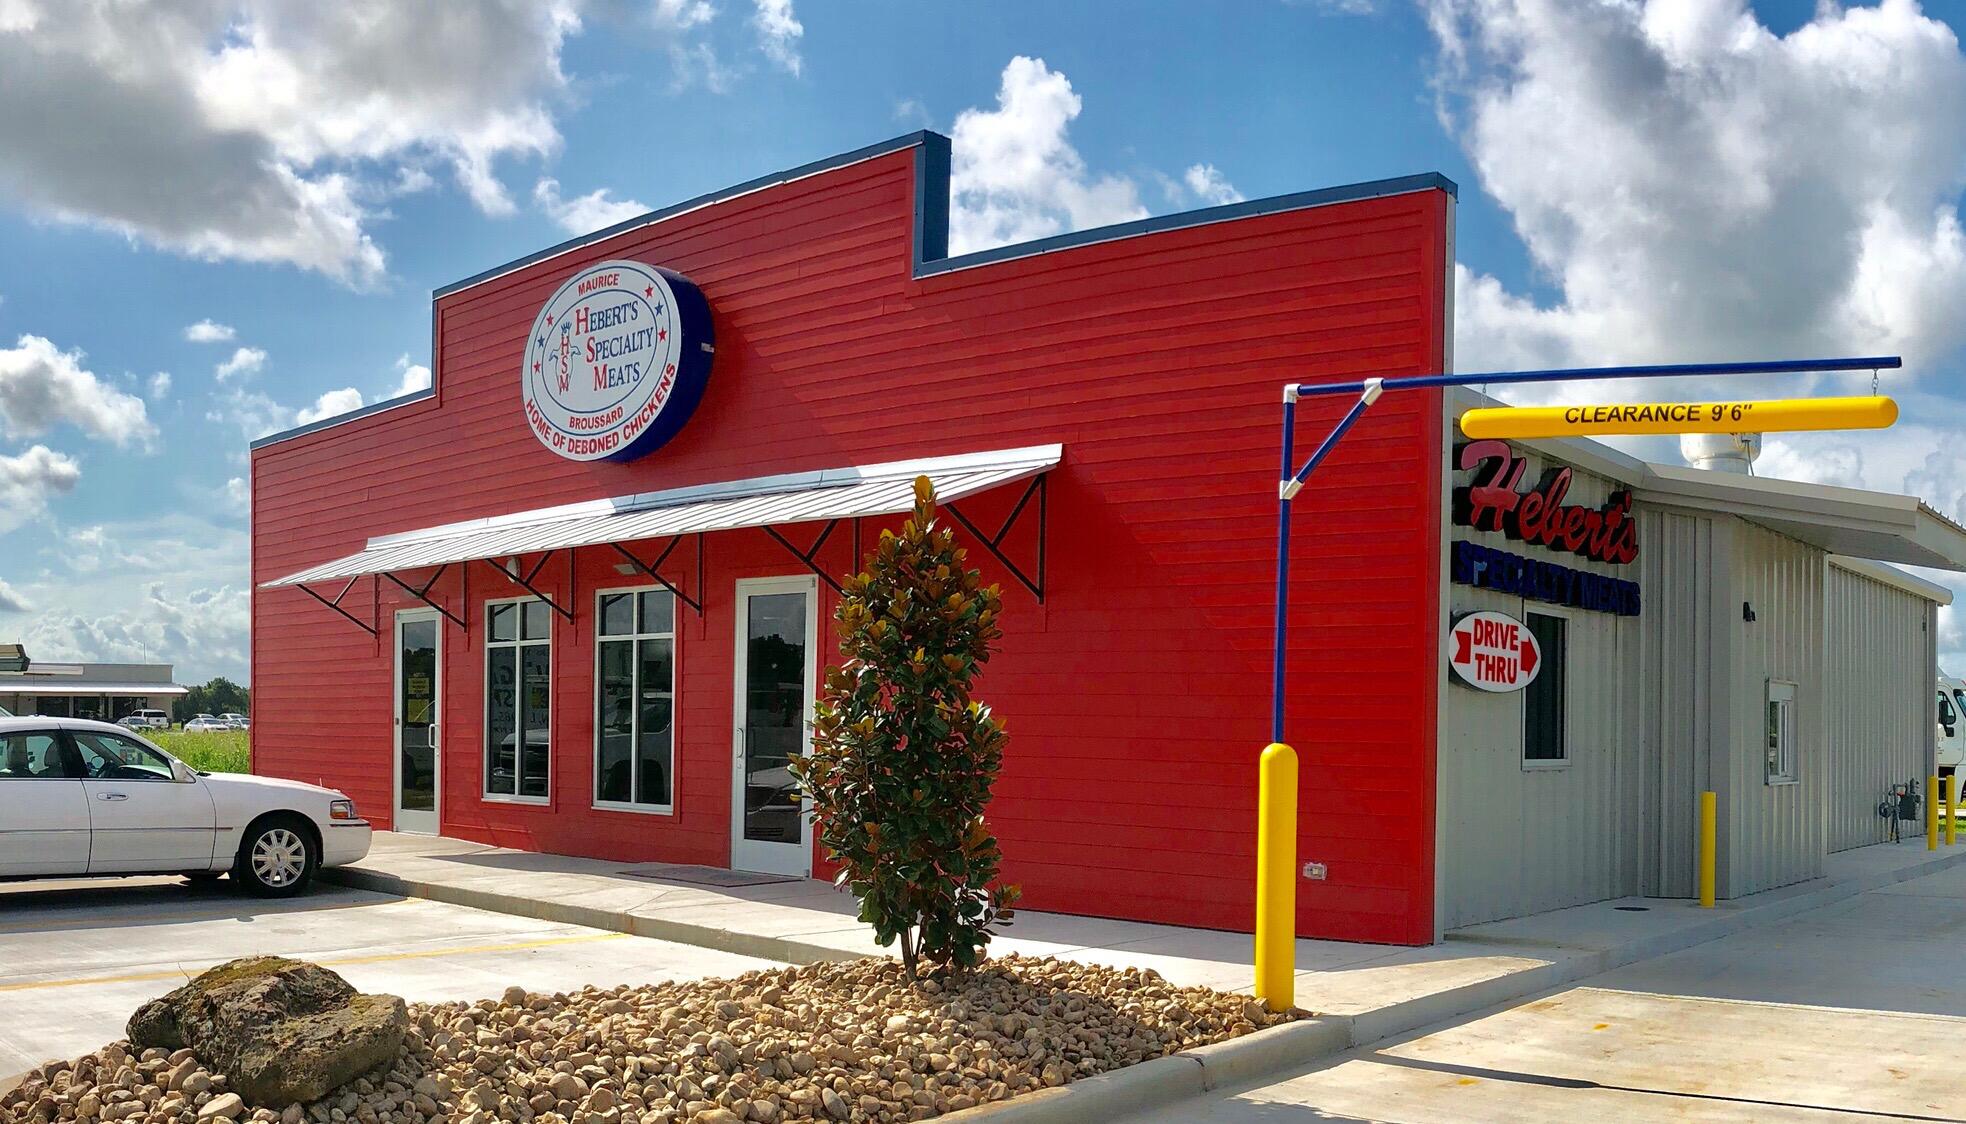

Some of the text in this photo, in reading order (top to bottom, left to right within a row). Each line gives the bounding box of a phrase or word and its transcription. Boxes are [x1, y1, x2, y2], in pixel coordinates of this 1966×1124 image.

[578, 273, 620, 296] MAURICE
[575, 300, 639, 336] HEBERT'S
[586, 326, 654, 364] SPECIALTY
[593, 361, 640, 392] MEATS
[525, 362, 676, 455] HOME OF DEBONED CHICKENS
[569, 406, 624, 430] BROUSSARD
[1565, 405, 1701, 424] CLEARANCE
[1461, 440, 1639, 564] Hebert's
[1455, 540, 1576, 607] SPECIALTY
[1473, 618, 1519, 652] DRIVE
[1475, 653, 1518, 684] THRU
